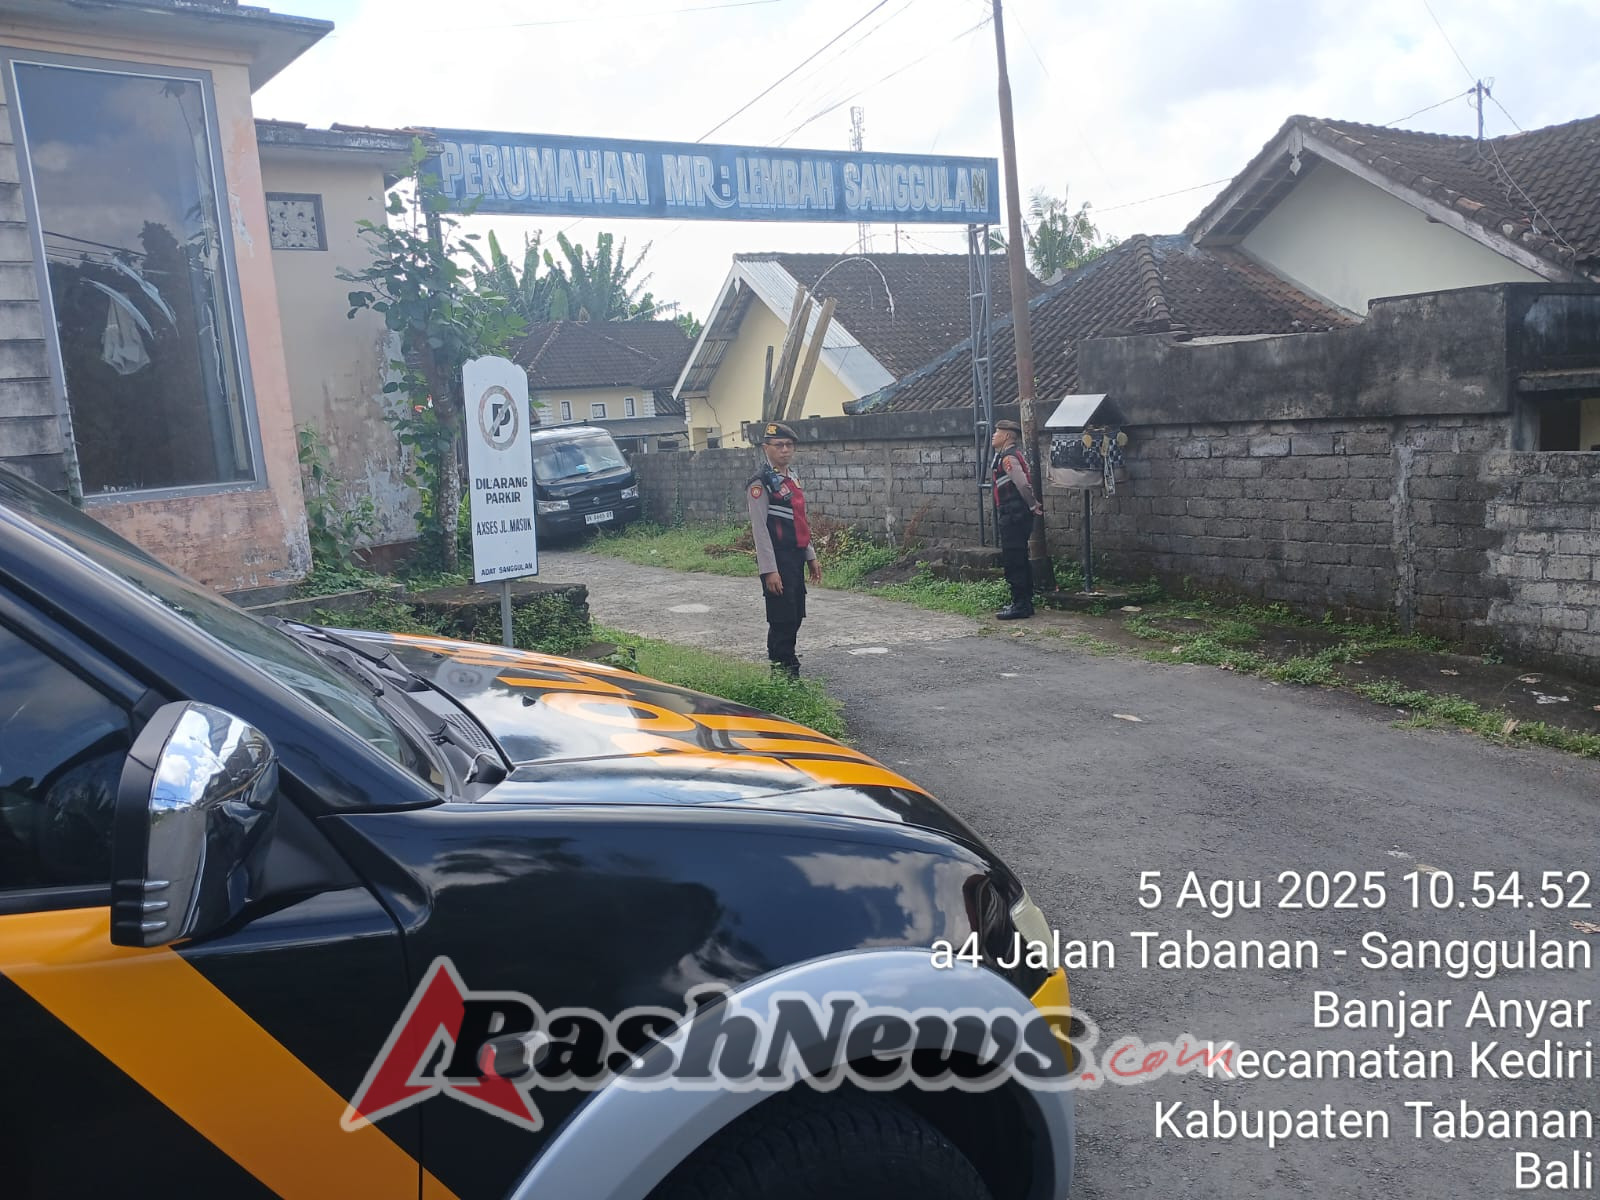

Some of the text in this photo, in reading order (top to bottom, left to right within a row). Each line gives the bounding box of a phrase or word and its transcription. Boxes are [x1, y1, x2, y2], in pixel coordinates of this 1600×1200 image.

[440, 141, 650, 205] PERUMAHAN
[736, 157, 836, 210] LEMBAH
[843, 162, 989, 213] SANGGULAN
[475, 477, 528, 490] DILARANG
[485, 491, 521, 505] PARKIR
[476, 520, 499, 536] AXSES
[481, 567, 497, 576] ADAT
